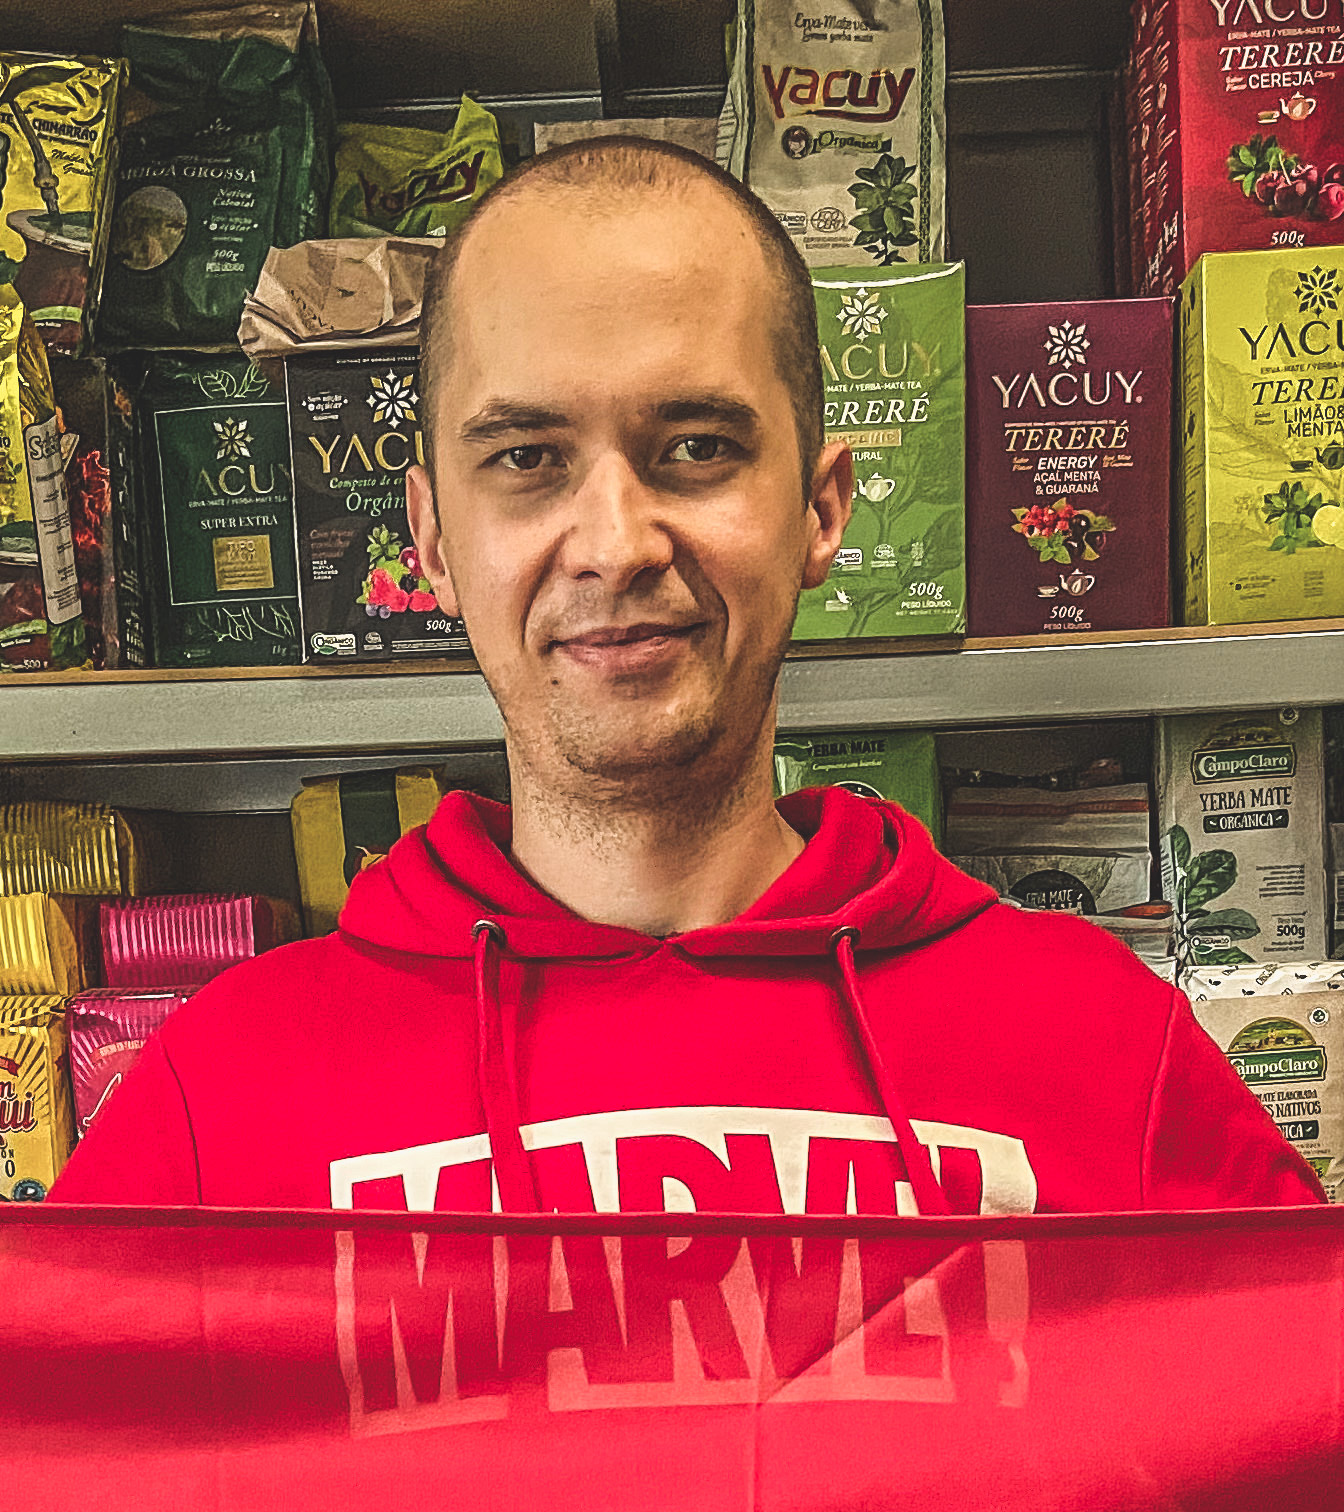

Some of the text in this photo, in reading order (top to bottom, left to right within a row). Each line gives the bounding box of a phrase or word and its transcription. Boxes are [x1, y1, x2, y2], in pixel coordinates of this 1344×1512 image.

[1249, 71, 1315, 89] CEREJA
[762, 65, 916, 121] yacuy
[184, 165, 256, 183] GROSSA
[1270, 230, 1305, 248] 500g
[992, 370, 1136, 409] YACUY
[1005, 420, 1129, 452] TERERÉ
[1287, 420, 1344, 438] MENTA
[1038, 455, 1097, 470] ENERGY
[200, 514, 278, 529] SUPER EXTRA
[908, 582, 944, 600] 500g
[901, 600, 922, 610] PESO
[1050, 605, 1084, 623] 500g
[426, 620, 452, 632] 500g
[1198, 751, 1291, 780] CampoClaro
[1201, 787, 1292, 811] YERBA MATE
[1219, 812, 1274, 829] ORGÁNICA
[1276, 923, 1306, 940] 500g
[1276, 1102, 1321, 1117] NATIVOS
